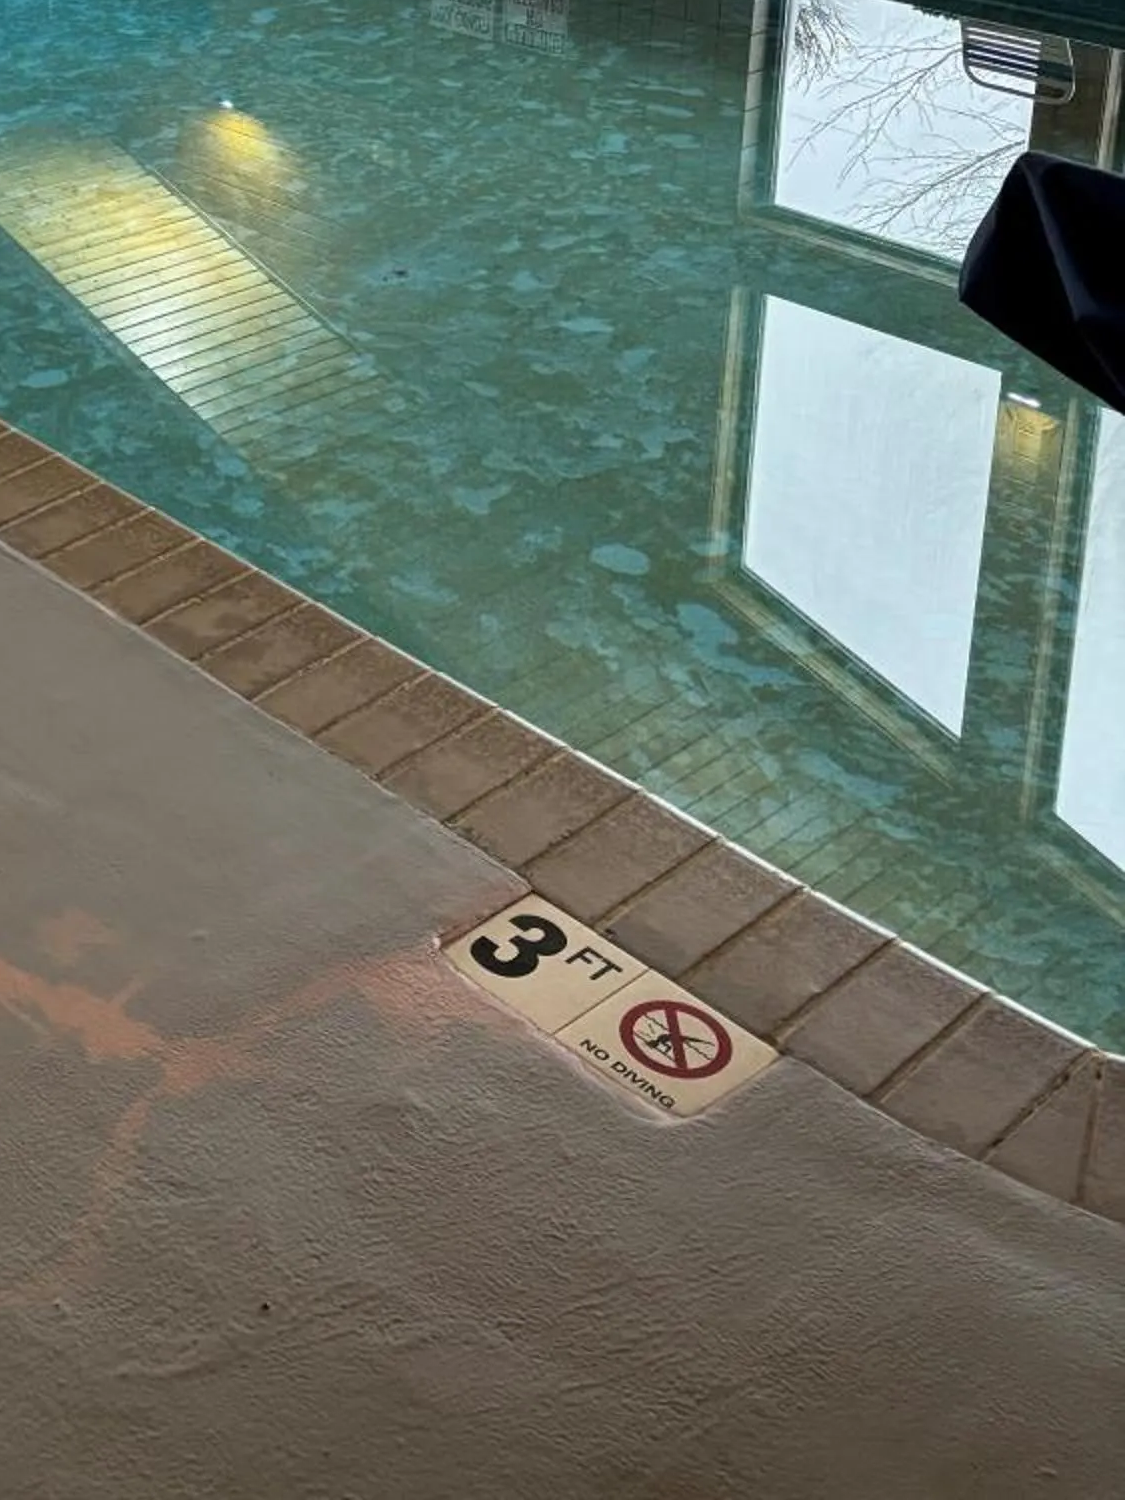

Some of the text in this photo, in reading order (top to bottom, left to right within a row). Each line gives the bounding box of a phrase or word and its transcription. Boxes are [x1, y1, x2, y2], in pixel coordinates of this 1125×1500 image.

[469, 914, 623, 980] 3 FT
[579, 1038, 675, 1110] NO DIVING
